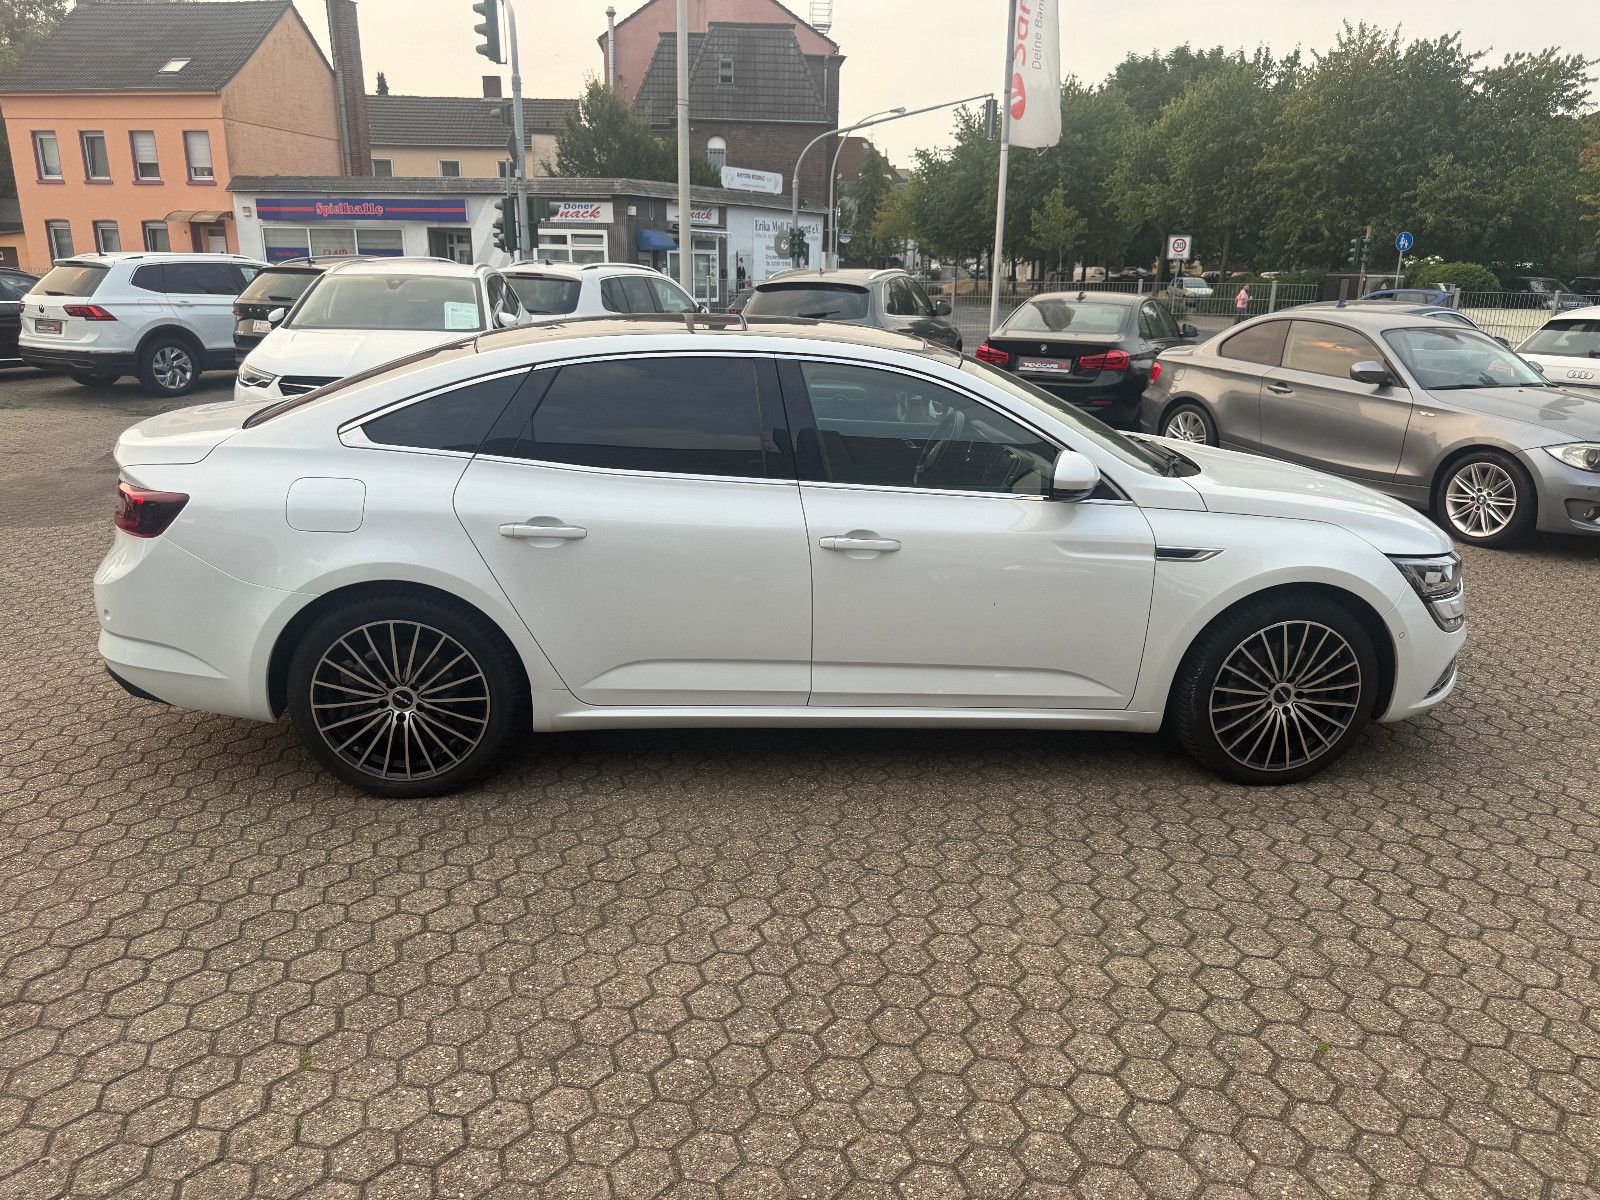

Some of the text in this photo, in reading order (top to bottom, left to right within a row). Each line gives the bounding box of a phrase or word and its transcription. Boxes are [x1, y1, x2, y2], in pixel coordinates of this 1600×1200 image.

[1032, 0, 1045, 69] Deine Ban
[315, 203, 384, 217] Spielhalle
[557, 205, 602, 218] nack
[563, 202, 594, 210] Döner
[687, 207, 713, 220] nack
[754, 219, 771, 232] Erika
